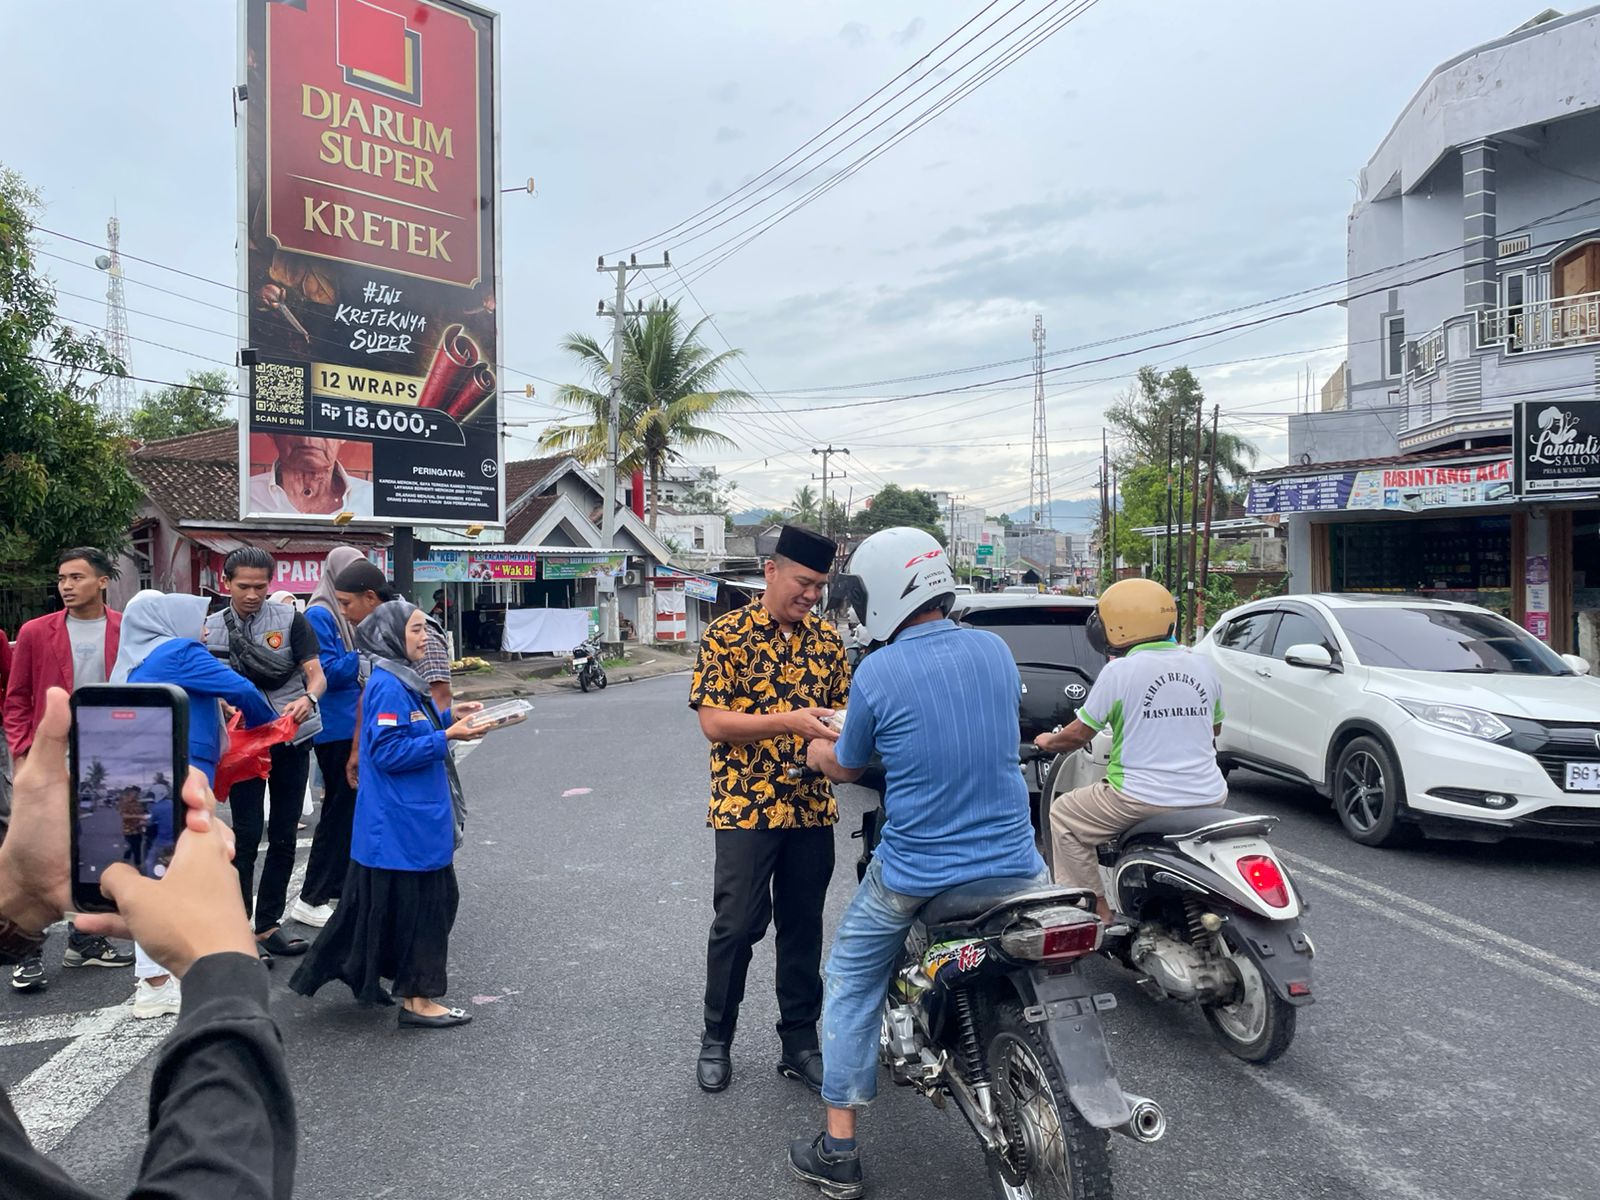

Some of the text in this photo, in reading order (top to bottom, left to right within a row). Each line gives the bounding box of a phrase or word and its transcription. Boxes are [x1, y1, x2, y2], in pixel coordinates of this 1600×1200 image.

[302, 83, 455, 159] DJARUM
[320, 131, 440, 192] SUPER
[303, 196, 453, 262] KRETEK
[363, 281, 402, 305] #INI
[334, 304, 427, 333] KRETEKNYA
[350, 329, 415, 354] SUPER
[320, 371, 418, 398] 12 WRAPS
[255, 415, 278, 424] SCAN
[289, 418, 305, 426] SINI
[321, 403, 438, 438] Rp 18.000,-
[412, 466, 466, 478] PERINGATAN:
[483, 464, 497, 472] 21+
[1476, 461, 1513, 481] ALA
[1555, 455, 1600, 467] SALON
[502, 565, 521, 576] Wak
[1143, 672, 1208, 708] SEHAT BERSAMA
[1142, 707, 1208, 720] MASYARAKAT
[1572, 766, 1590, 780] BG
